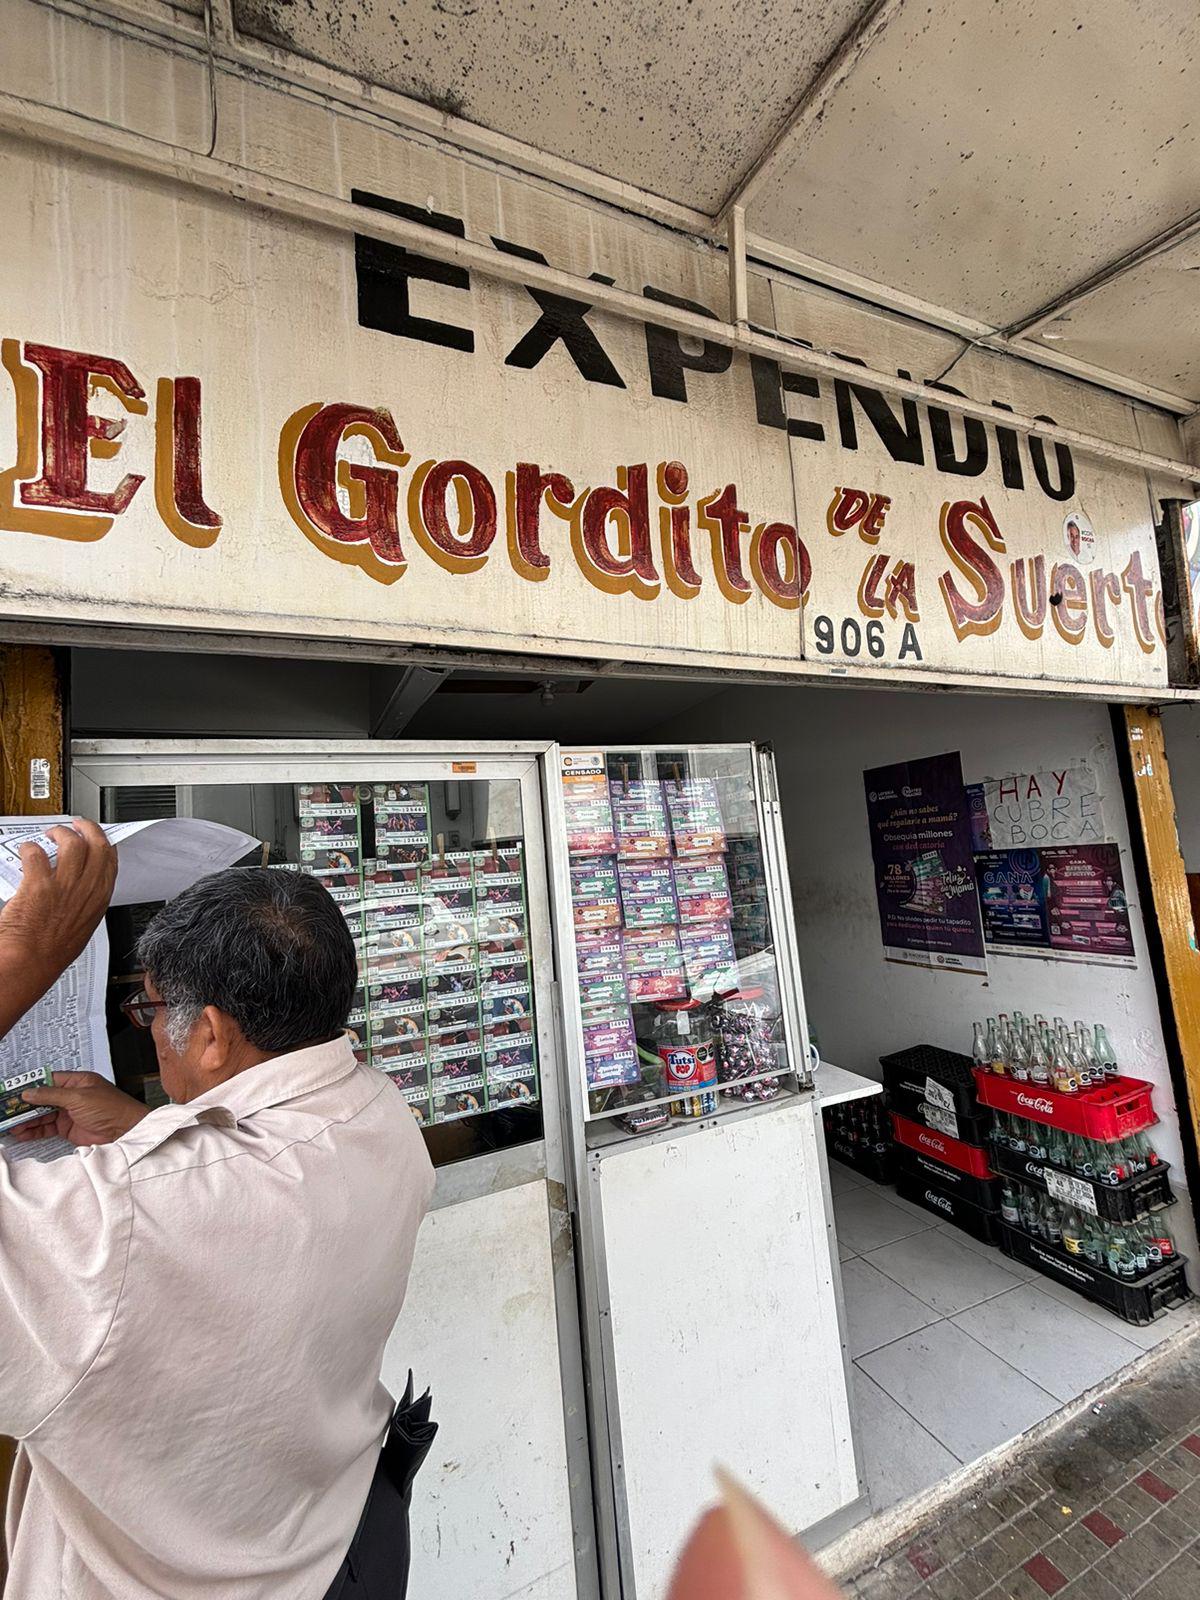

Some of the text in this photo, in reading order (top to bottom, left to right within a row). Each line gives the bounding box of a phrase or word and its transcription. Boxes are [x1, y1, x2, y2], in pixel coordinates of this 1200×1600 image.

[352, 189, 1075, 501] EXPENDIO
[1, 338, 1166, 654] El Gordito DE LA Suert
[814, 615, 922, 661] 906 A
[564, 768, 602, 776] CENSADO
[1000, 770, 1067, 803] HAY
[917, 804, 938, 814] sabes
[928, 812, 958, 823] mamá?
[993, 792, 1096, 824] CUBRE
[883, 830, 953, 843] Obsequia millones
[1010, 820, 1099, 844] BOCA
[887, 863, 902, 875] 78
[983, 871, 1034, 884] GANA
[667, 1053, 695, 1065] Tutsi
[6, 1069, 43, 1088] 23702
[675, 1064, 691, 1075] POP
[1017, 1092, 1054, 1115] Coca-Cola
[918, 1133, 947, 1153] Coca-Cola
[925, 1189, 953, 1213] Coca-Cola
